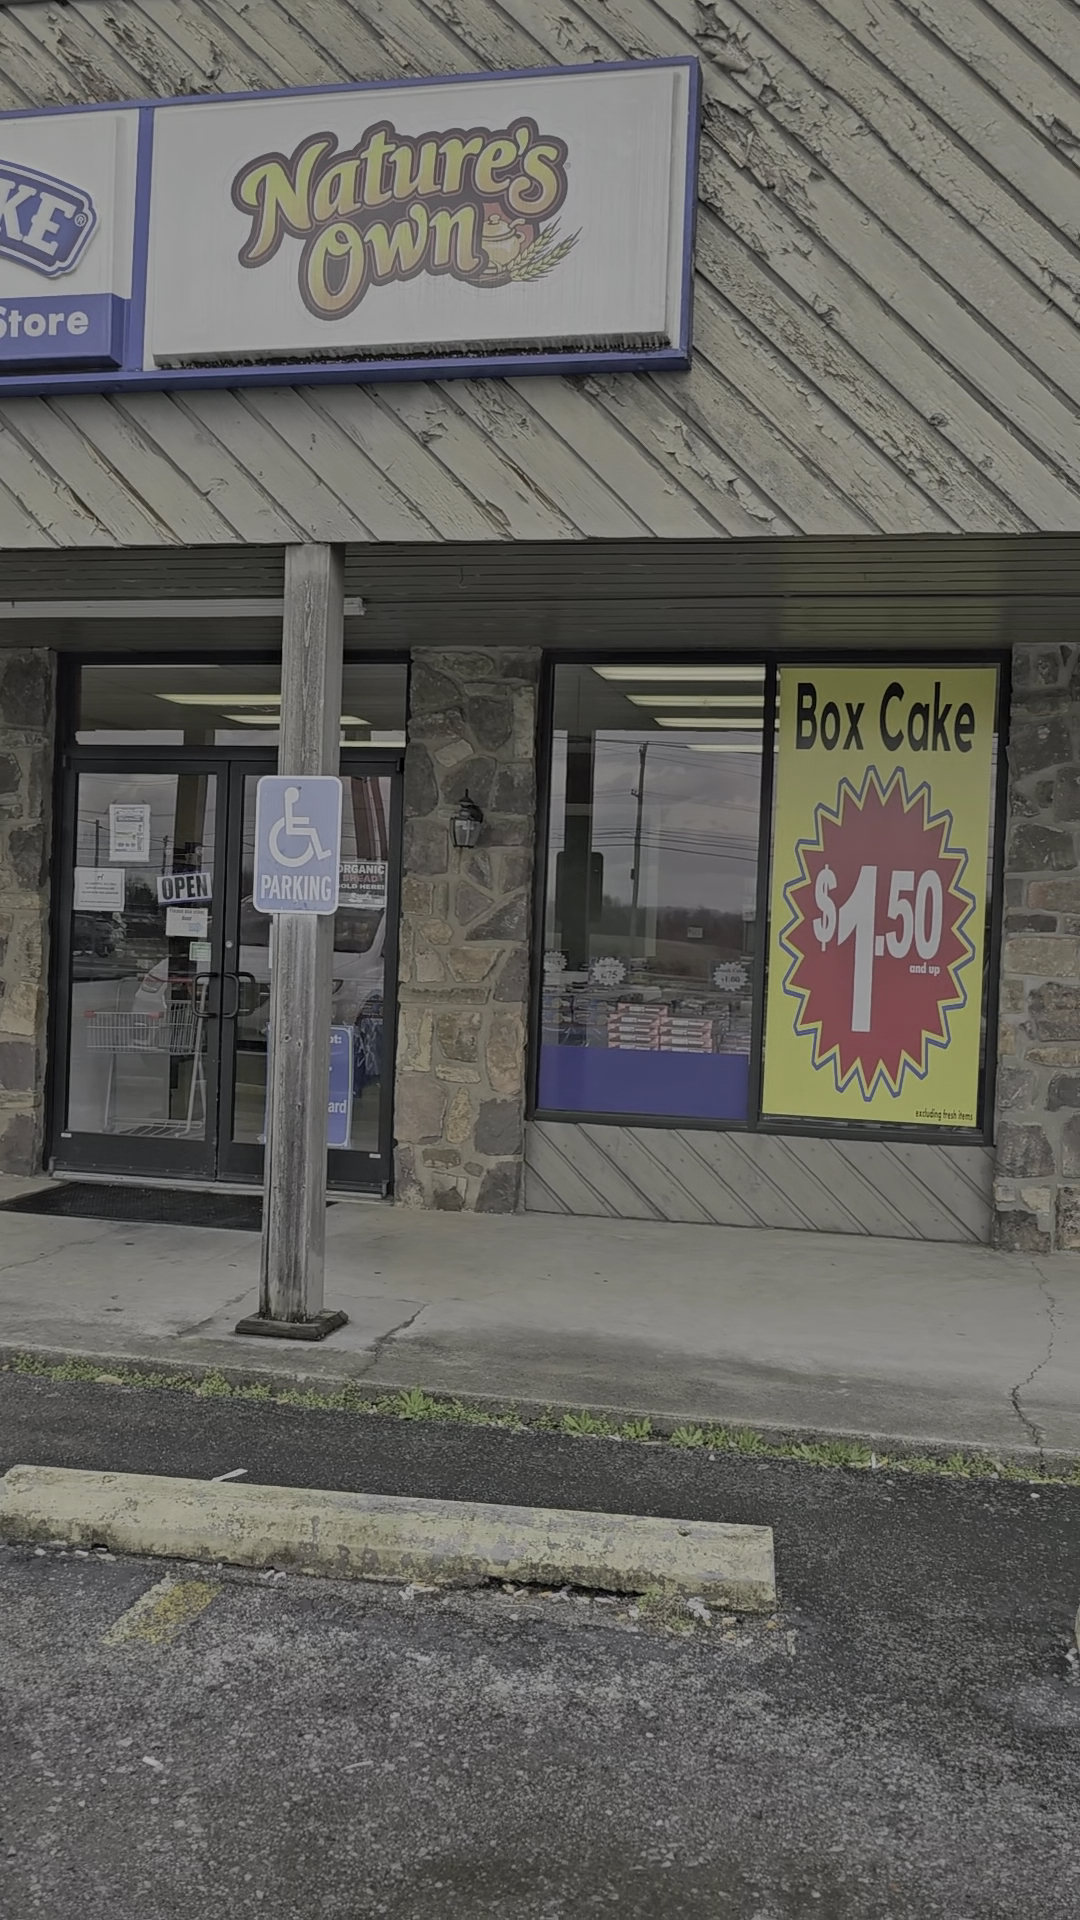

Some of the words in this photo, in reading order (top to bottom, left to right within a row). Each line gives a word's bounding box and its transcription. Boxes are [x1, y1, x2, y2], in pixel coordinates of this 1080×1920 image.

[239, 126, 559, 260] Nature's
[0, 178, 77, 257] KE
[306, 203, 481, 311] Own
[796, 682, 865, 750] Box
[880, 681, 975, 753] Cake
[161, 874, 208, 900] OPEN
[260, 874, 332, 902] PARKING
[342, 874, 379, 883] BREAD
[812, 864, 943, 1032] $1.50
[909, 961, 927, 974] and
[928, 966, 941, 977] up
[327, 1099, 347, 1114] ard
[915, 1107, 942, 1122] excluding
[943, 1108, 957, 1120] fresh
[958, 1110, 973, 1121] items
